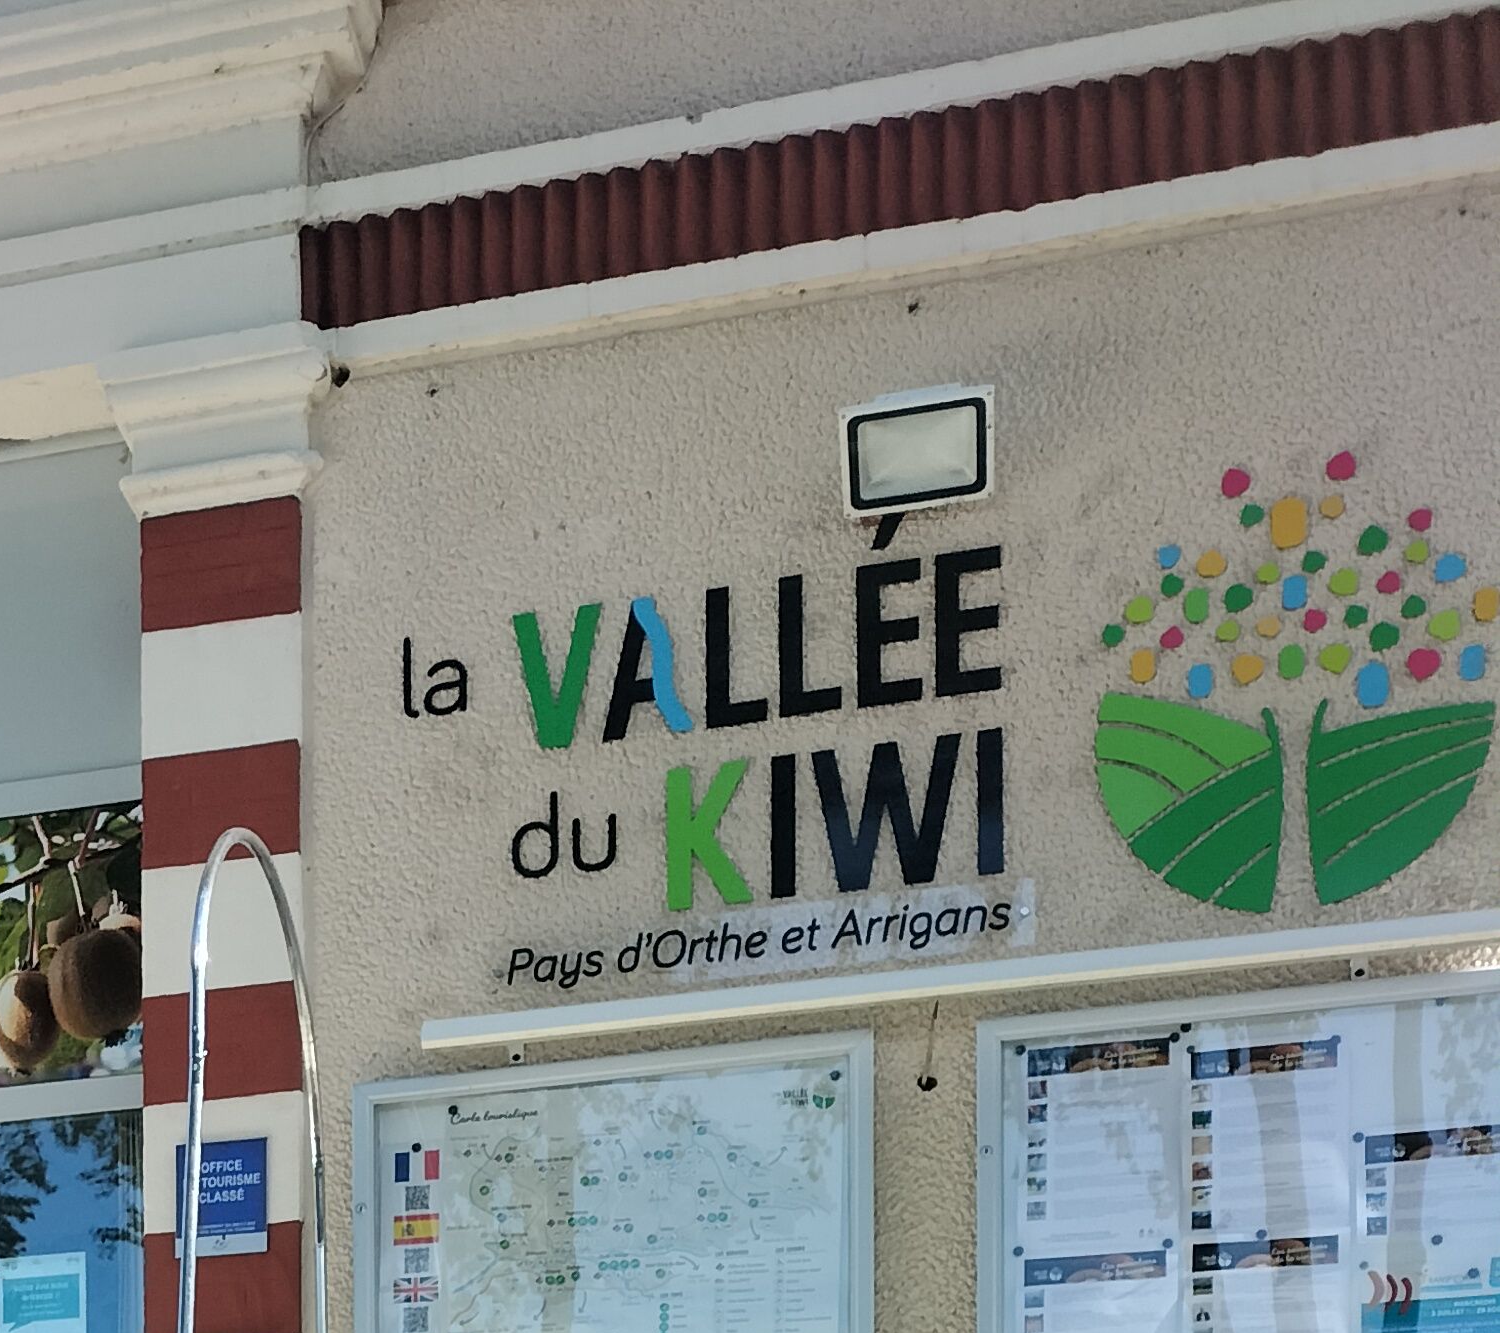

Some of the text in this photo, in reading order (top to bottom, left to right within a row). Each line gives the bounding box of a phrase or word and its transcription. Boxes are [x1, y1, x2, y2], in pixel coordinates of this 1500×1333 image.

[404, 513, 1003, 750] la VALLÉE
[510, 727, 1006, 914] du KIWI
[507, 897, 1012, 990] Pays d'Orthe et Arrigans
[200, 1159, 243, 1174] OFFICE
[201, 1172, 261, 1188] TOURISME
[199, 1188, 245, 1204] CLASSÉ
